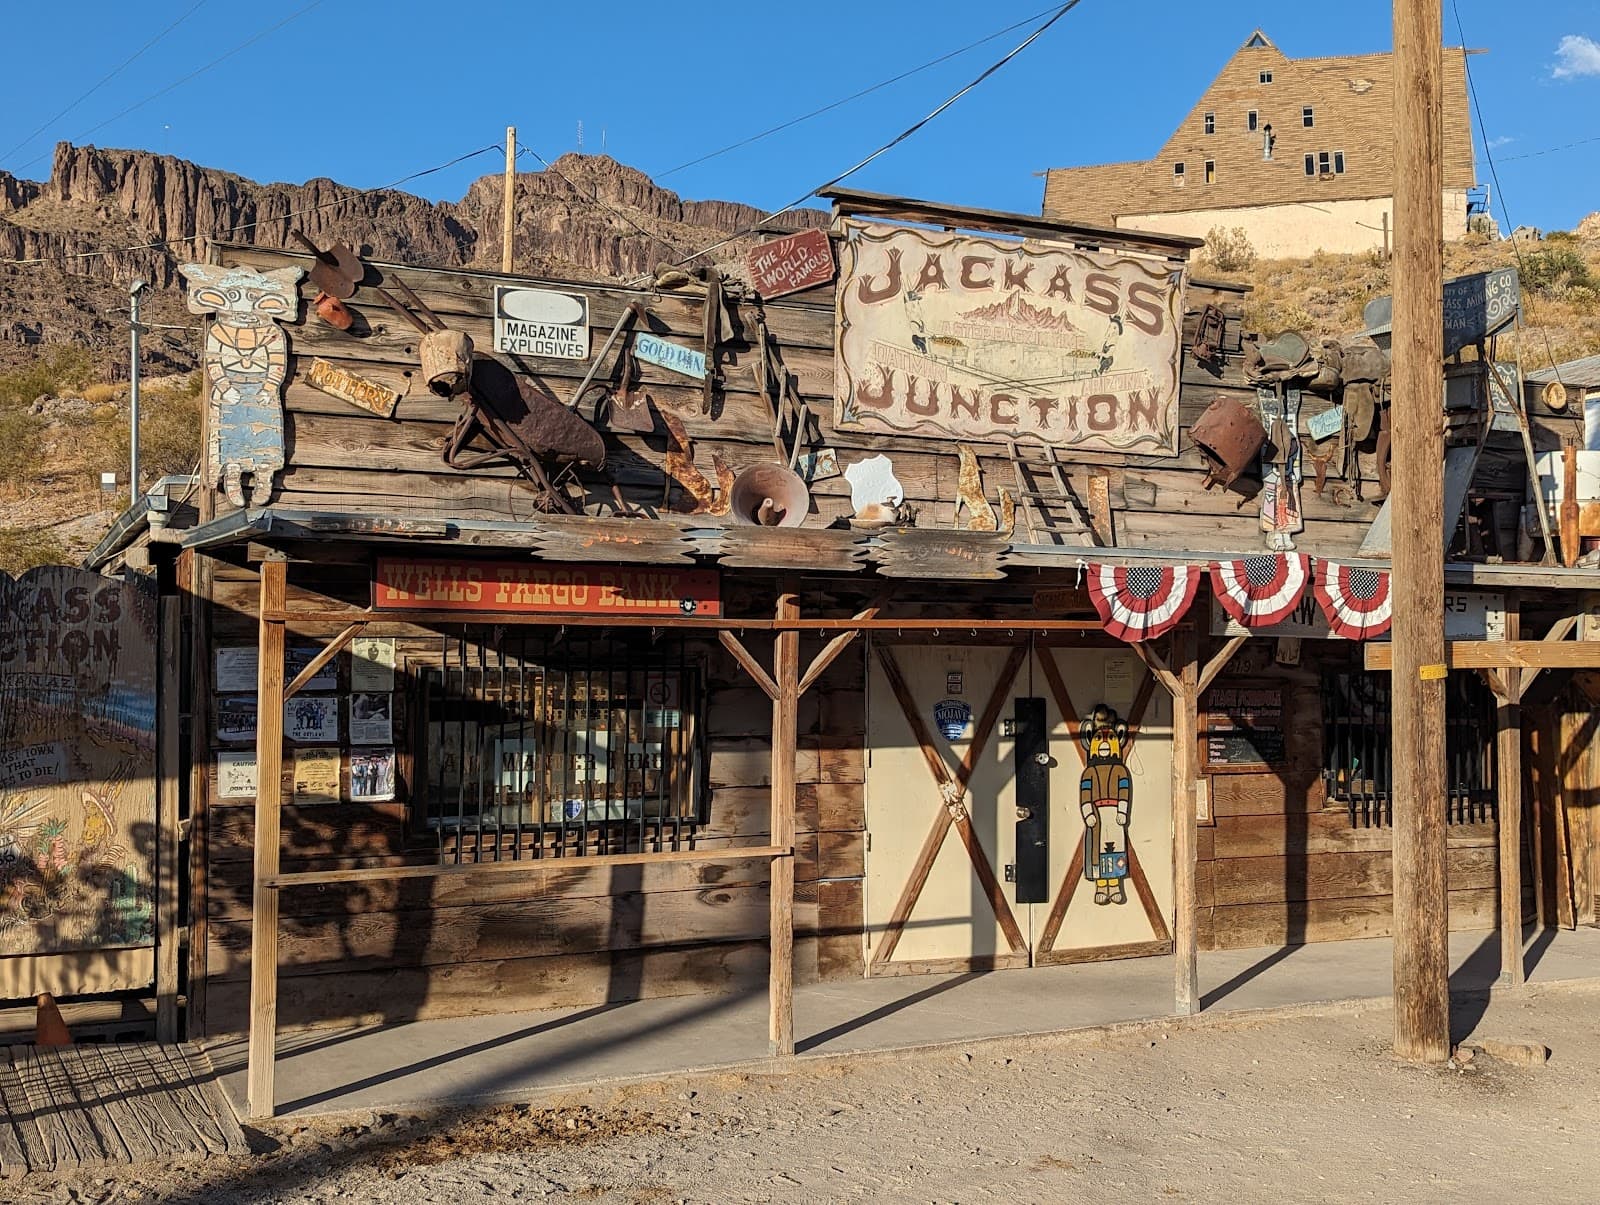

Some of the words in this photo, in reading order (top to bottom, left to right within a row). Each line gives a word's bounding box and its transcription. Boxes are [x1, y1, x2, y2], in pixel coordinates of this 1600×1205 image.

[755, 251, 778, 275] THE
[761, 247, 808, 288] WORLD
[789, 250, 829, 287] FAMOUS
[858, 246, 1167, 336] JACKASS
[507, 323, 577, 341] MAGAZINE
[500, 337, 583, 358] EXPLOSIVES
[639, 338, 674, 361] GOLD
[857, 362, 1159, 432] JUNCTION
[383, 564, 482, 603] WELLS
[496, 567, 589, 606] FARGO
[599, 571, 680, 609] BANK
[26, 745, 54, 758] TOWN
[6, 758, 36, 773] THAT
[18, 770, 32, 781] TO
[35, 761, 60, 777] DIE!
